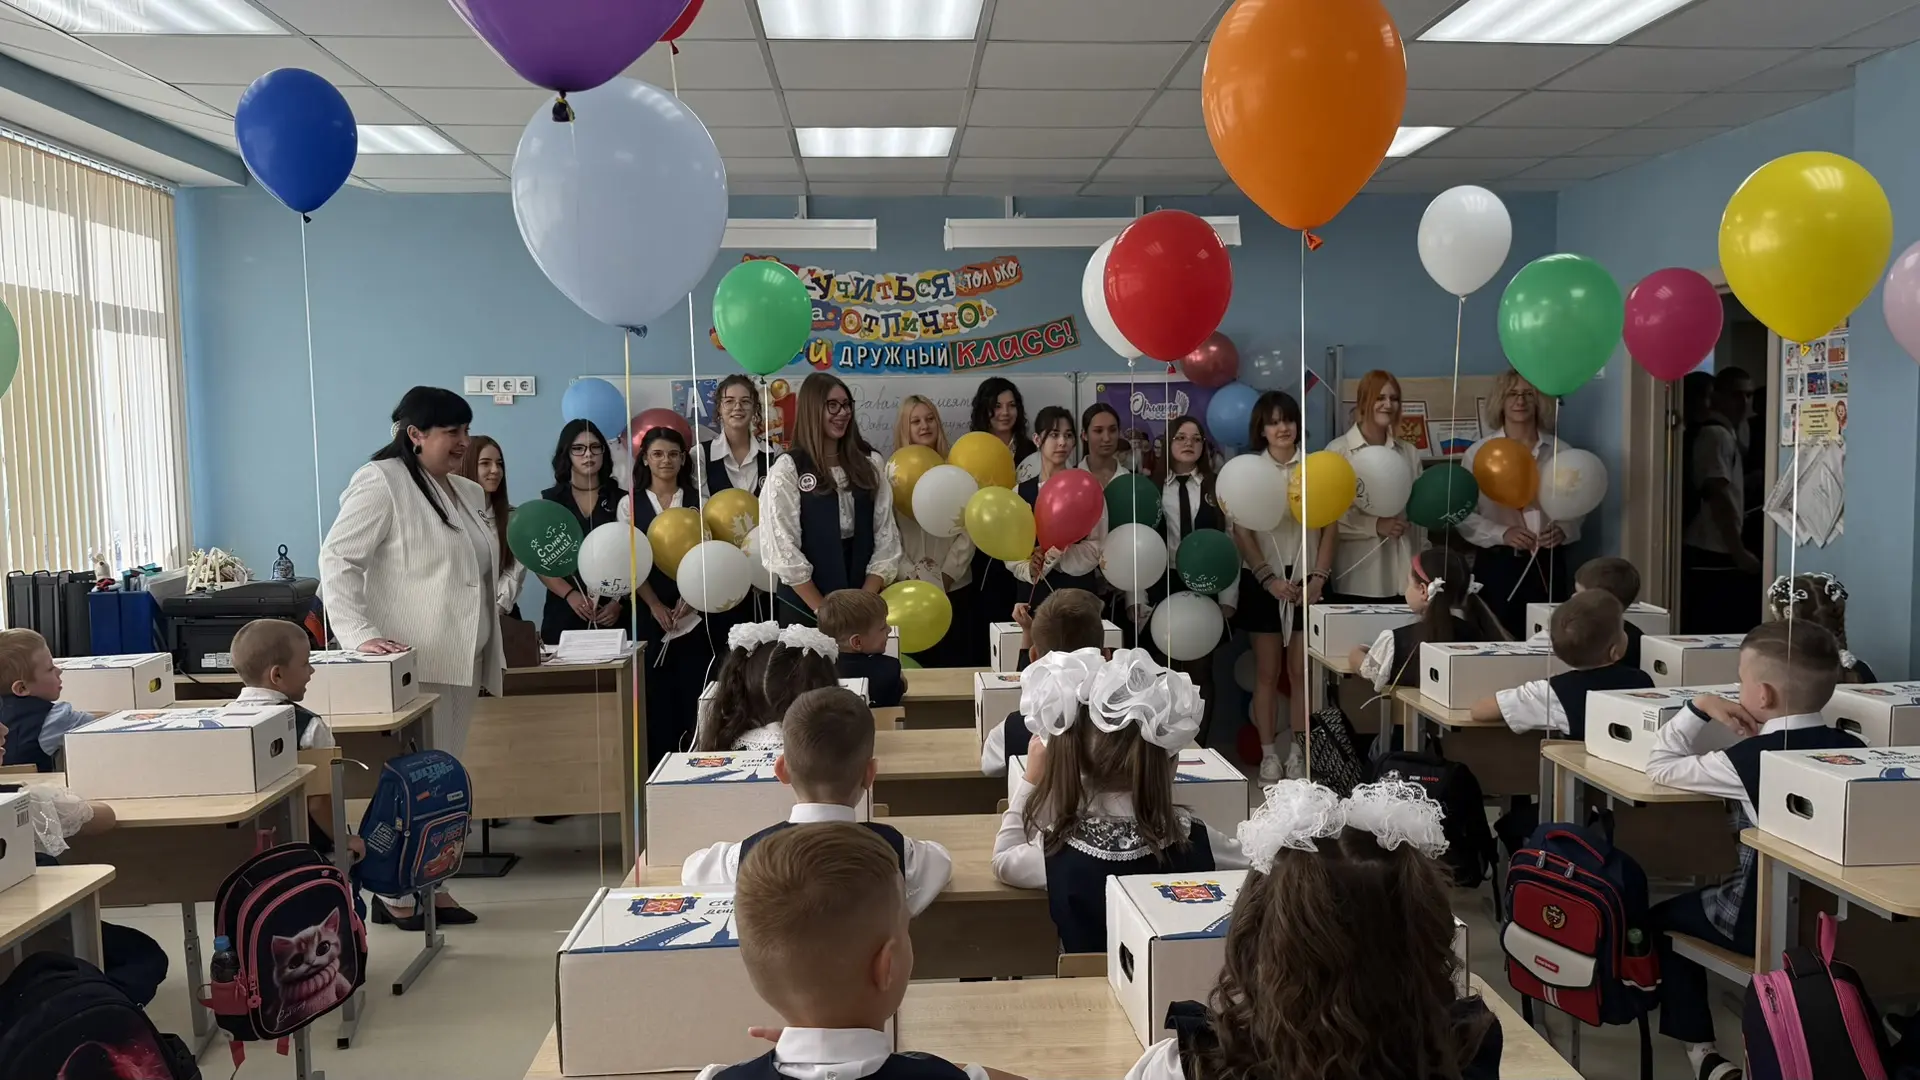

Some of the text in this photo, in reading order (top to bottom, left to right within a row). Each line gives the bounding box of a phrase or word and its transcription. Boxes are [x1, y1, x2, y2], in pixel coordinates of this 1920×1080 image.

[811, 304, 986, 338] а ОТЛИЧНО!
[839, 342, 949, 368] ДРУЖНЫЙ
[957, 320, 1074, 367] КЛАСС!
